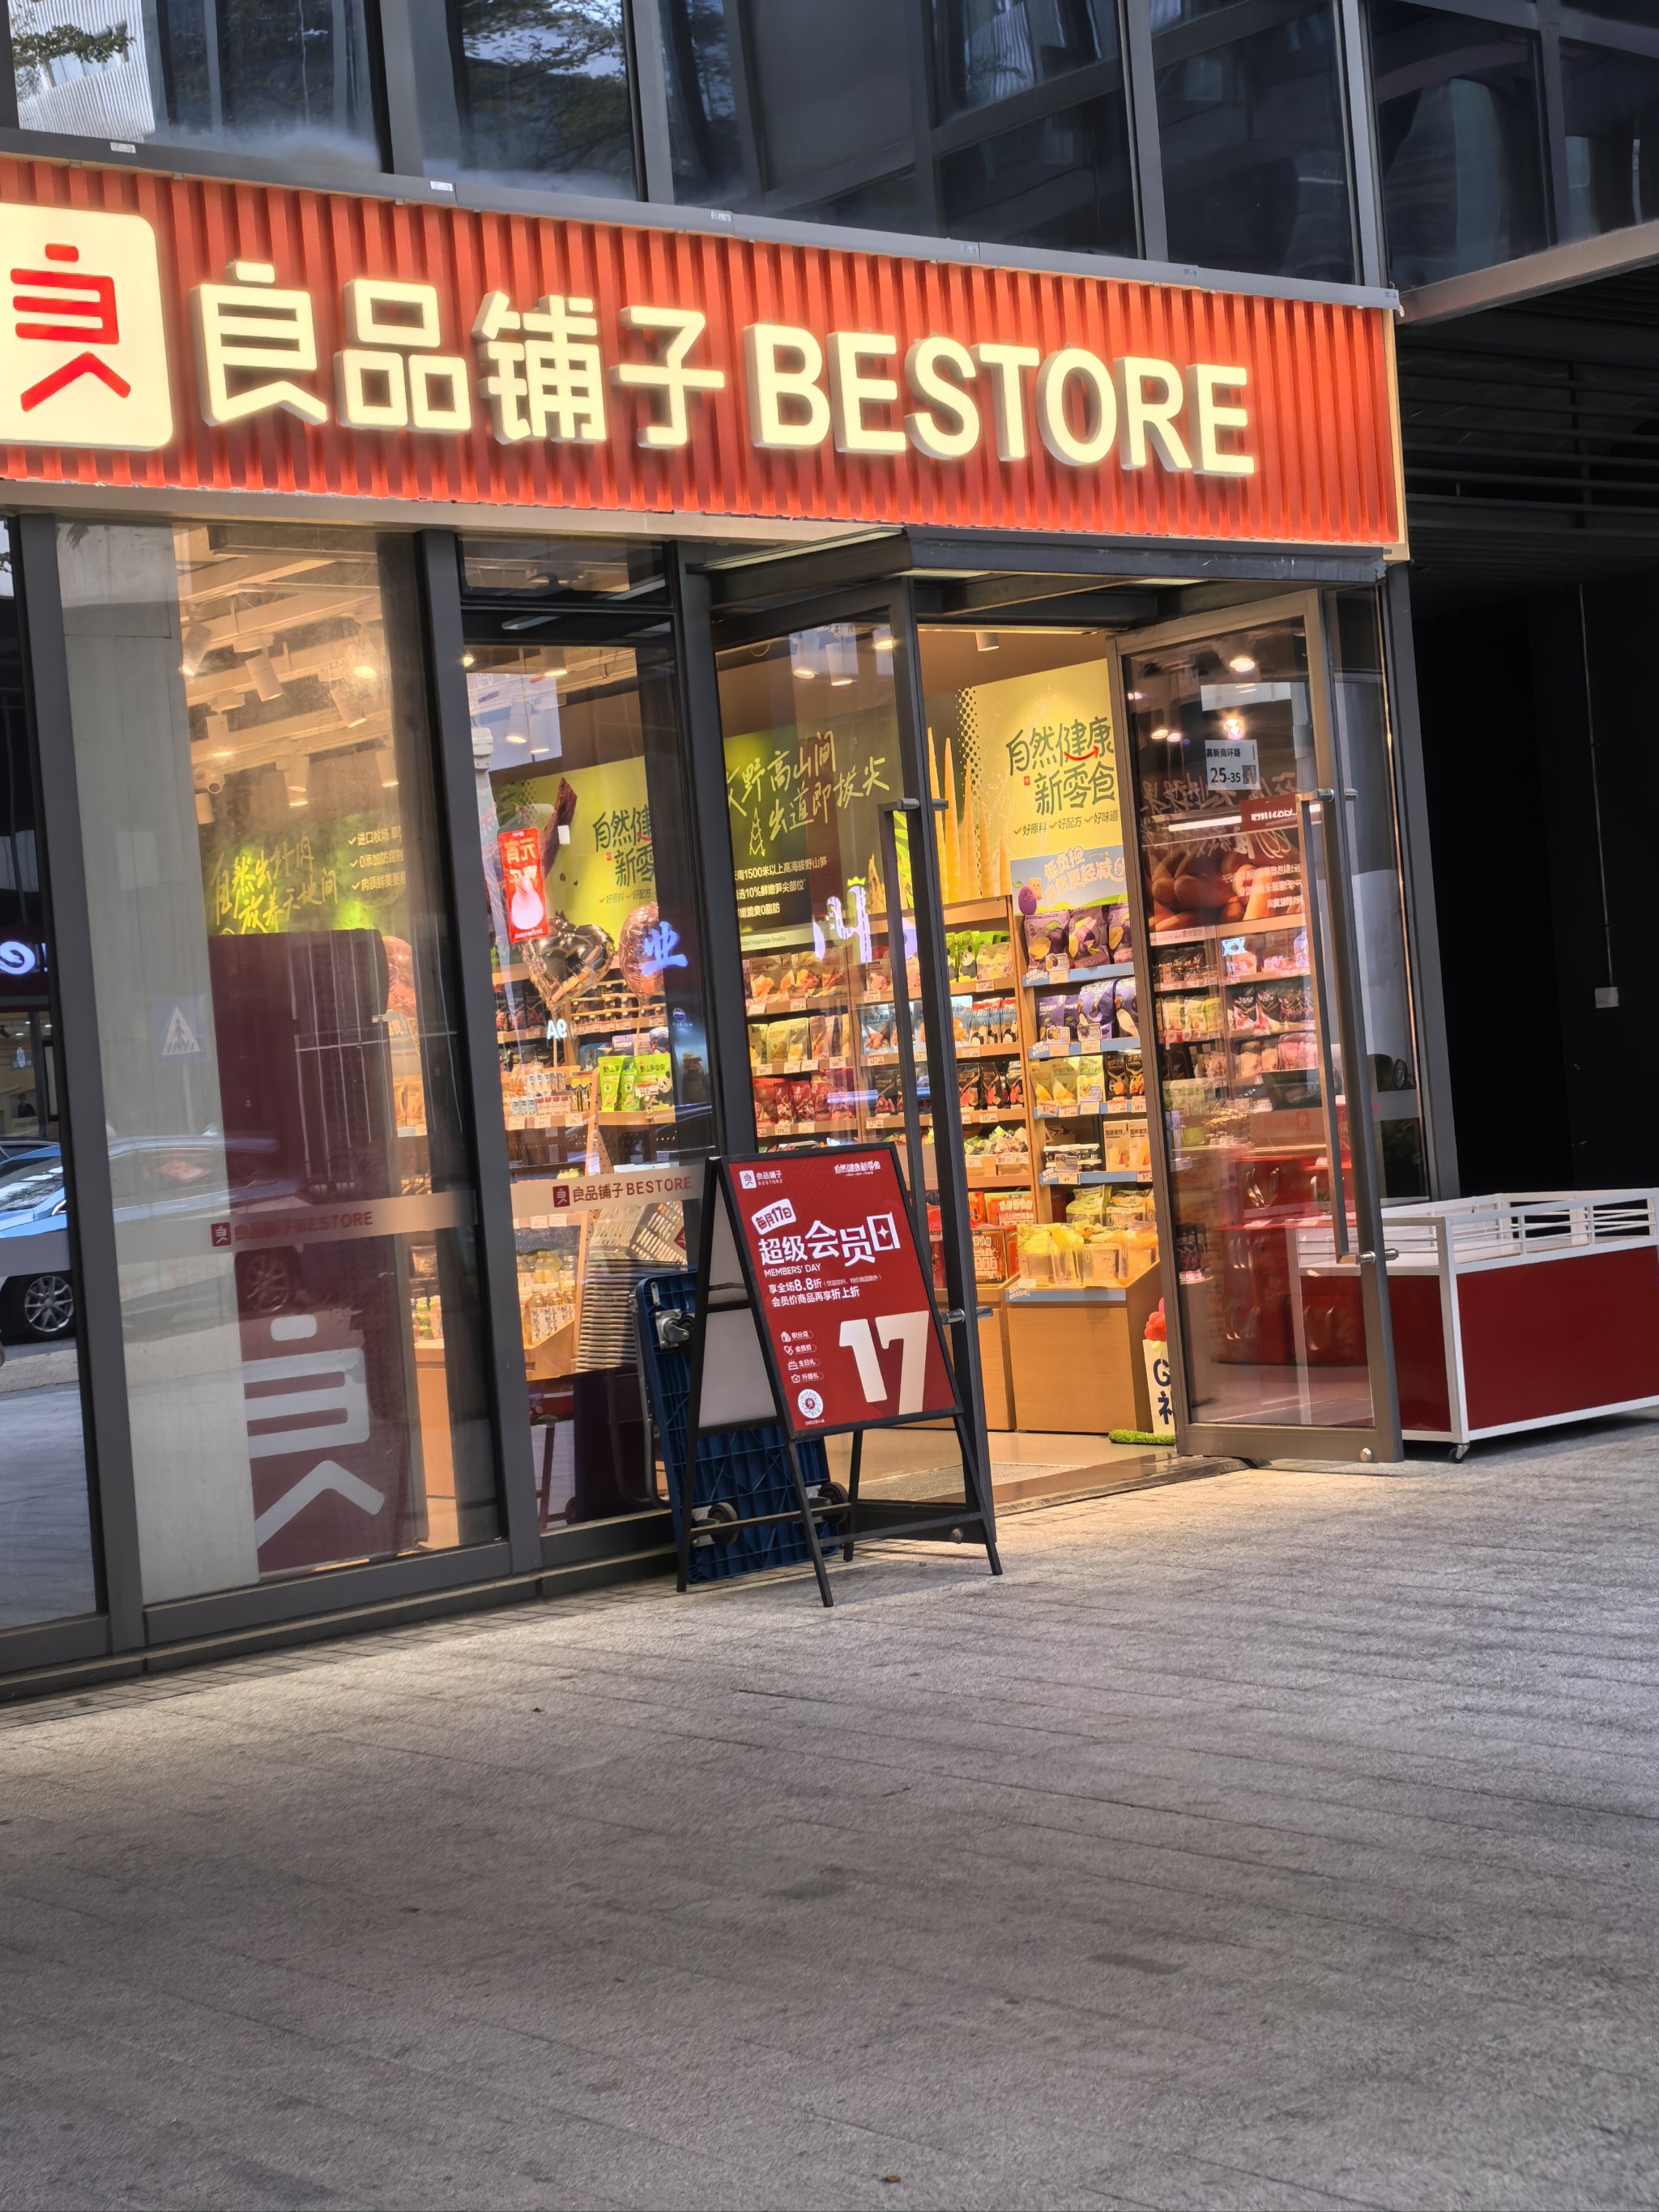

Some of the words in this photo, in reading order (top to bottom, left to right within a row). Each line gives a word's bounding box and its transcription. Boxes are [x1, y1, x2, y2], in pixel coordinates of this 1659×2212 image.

[190, 260, 726, 449] 良品铺子
[744, 321, 1255, 478] BESTORE
[1006, 716, 1115, 776] 自然健康
[727, 730, 836, 817] 野高山间
[1210, 766, 1241, 783] 25-35
[1034, 761, 1116, 816] 新零食
[1022, 822, 1047, 837] 好原料
[1058, 816, 1082, 830] 好配方
[1093, 809, 1120, 824] 好味道
[573, 1183, 624, 1203] 良品铺子
[627, 1175, 693, 1196] BESTORE
[756, 1206, 792, 1230] 每月17日
[805, 1263, 821, 1272] DAY
[768, 1277, 822, 1295] 享全场8.8折
[771, 1285, 860, 1307] 会员价商品再享折上折
[839, 1311, 930, 1416] 17
